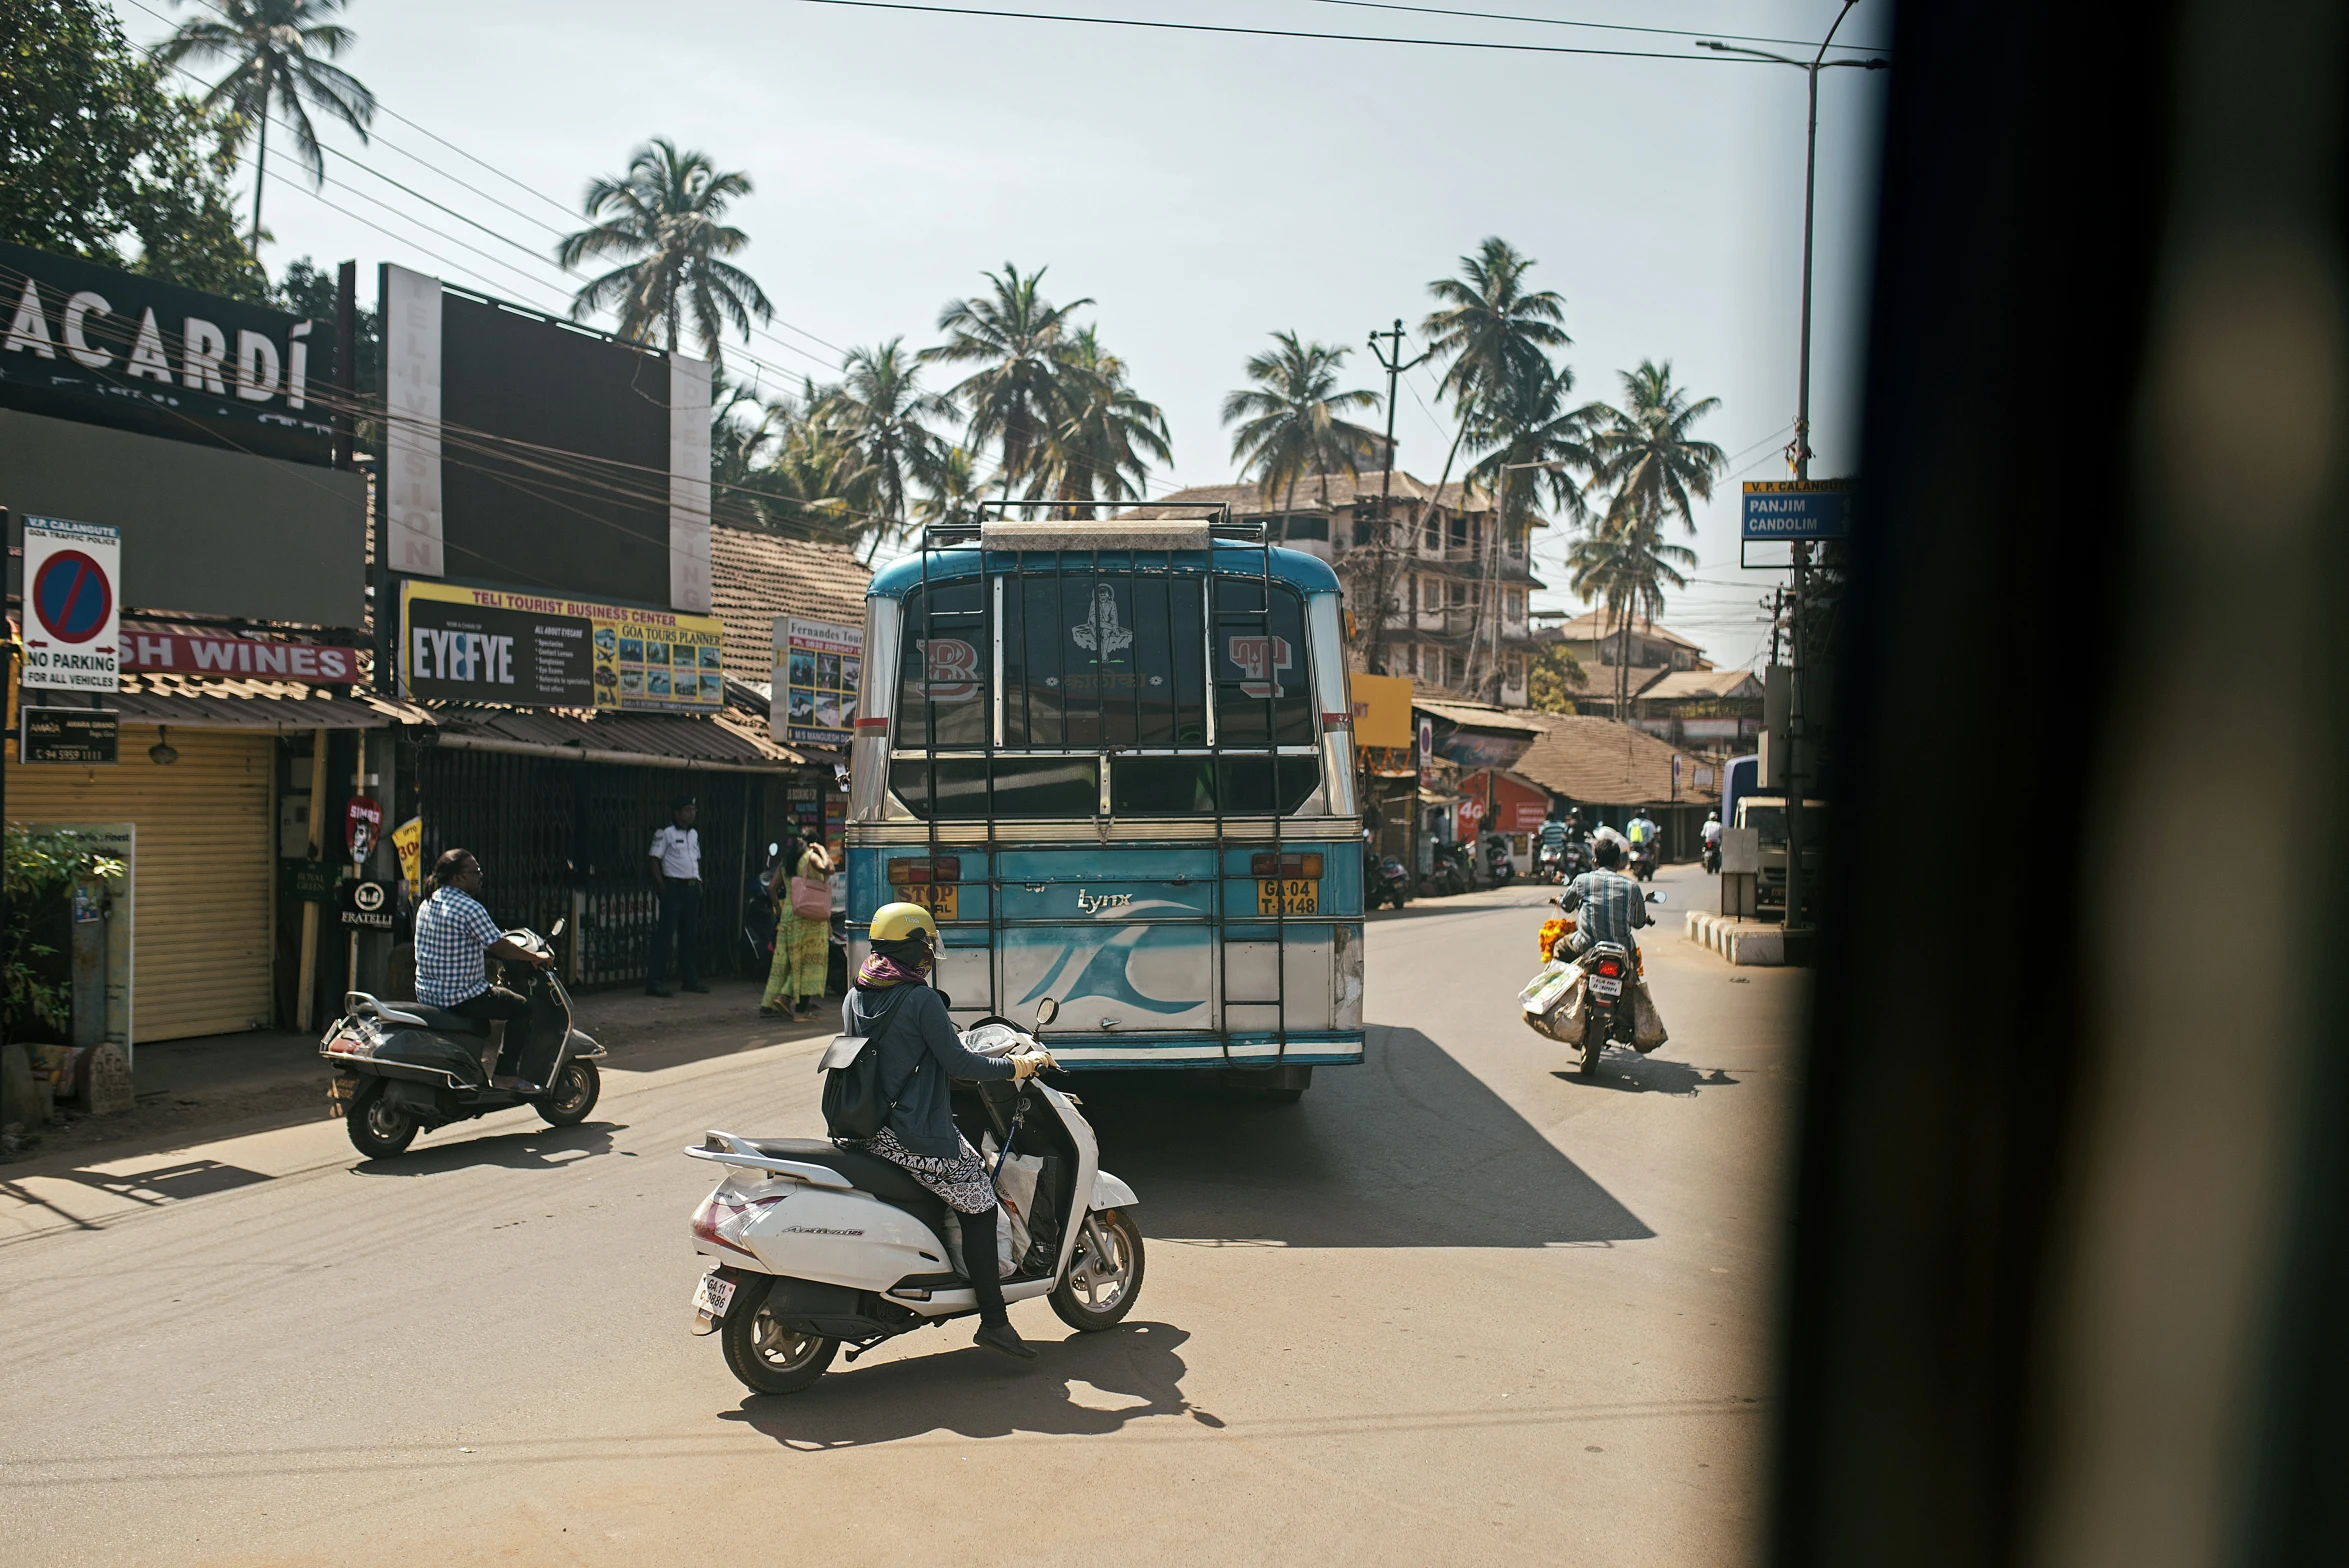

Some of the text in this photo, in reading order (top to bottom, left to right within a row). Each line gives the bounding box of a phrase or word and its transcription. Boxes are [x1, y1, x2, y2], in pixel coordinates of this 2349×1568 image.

[1750, 499, 1806, 513] PANJIM
[49, 520, 117, 537] CALANGUTE
[1749, 517, 1818, 531] CANDOLIM
[28, 528, 117, 546] GOA TRAFFIC POLICE
[472, 590, 502, 606] TELI
[507, 595, 563, 614] TOURIST
[567, 602, 628, 621] BUSINESS
[632, 611, 676, 627] CENTER
[622, 625, 721, 646] GOA TOURS PLANNER
[791, 622, 839, 641] Fernandes
[28, 651, 115, 672] NO PARKING
[190, 640, 347, 678] WINES
[28, 671, 114, 687] FOR ALL VEHICLES
[897, 886, 953, 903] STOP
[1077, 888, 1133, 915] Lynx
[341, 911, 393, 926] FRATELLI
